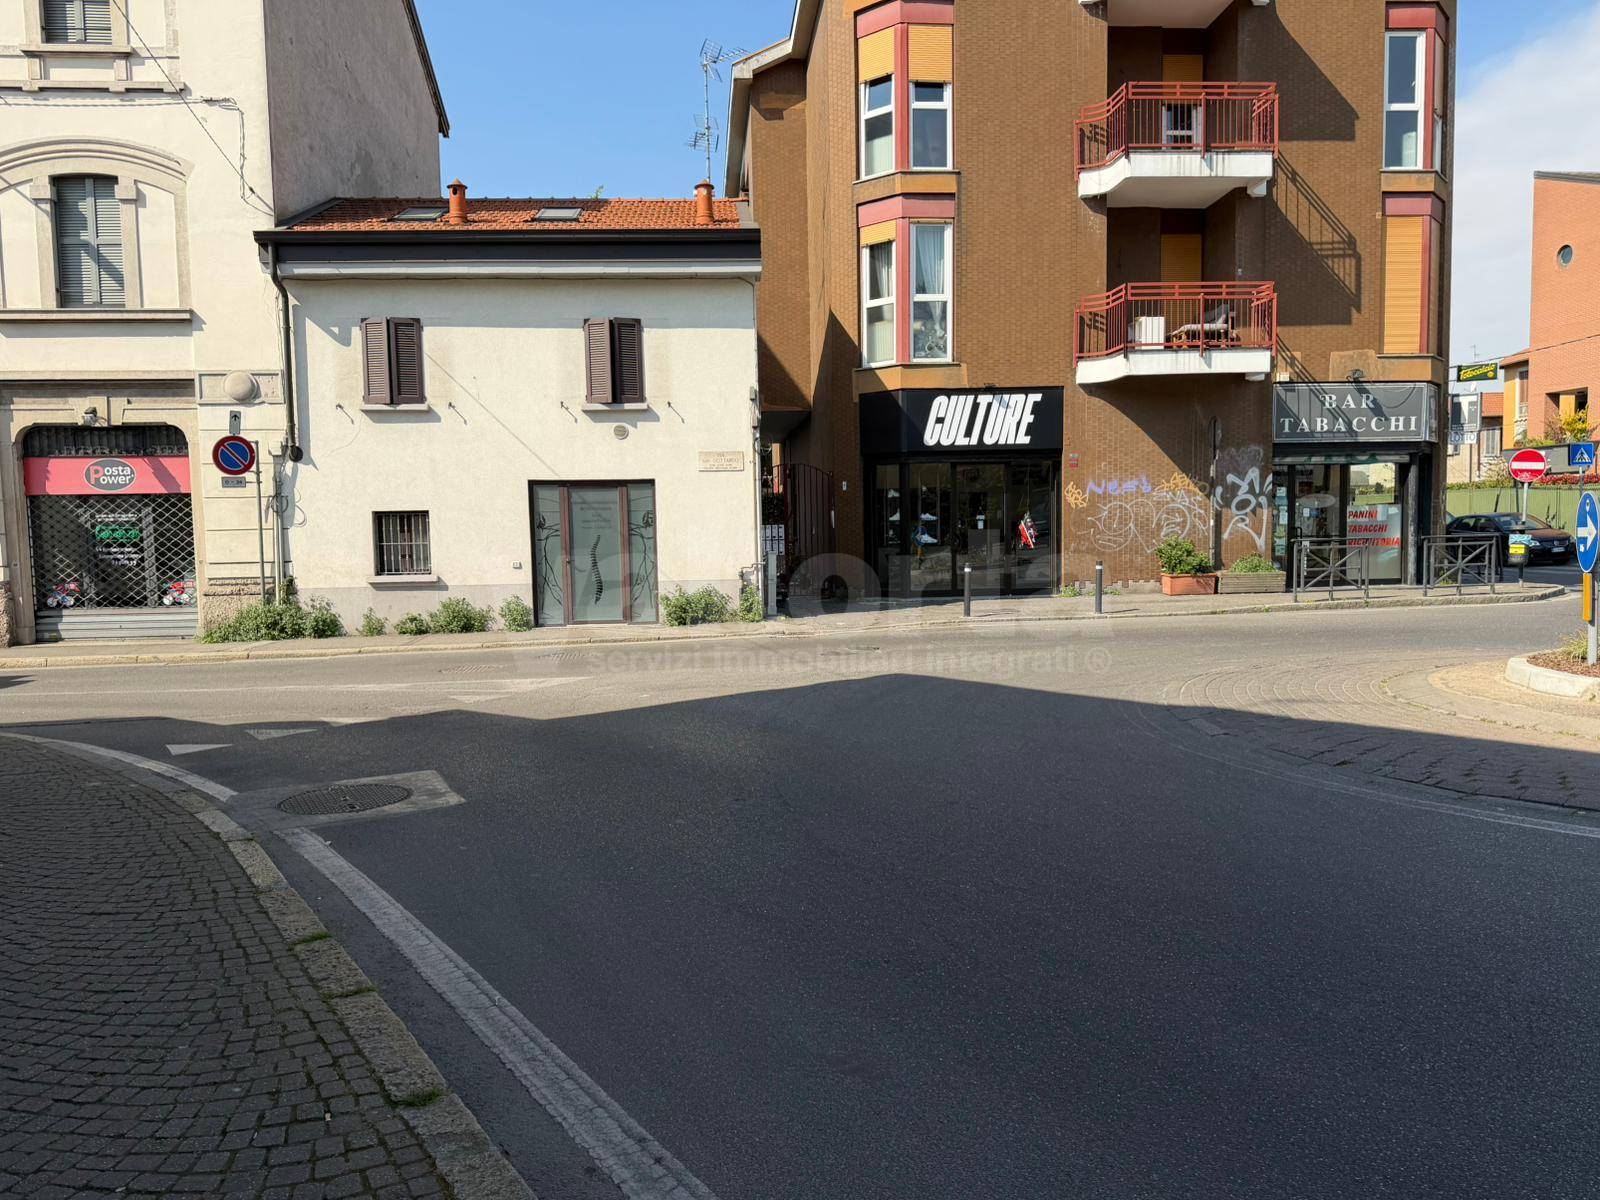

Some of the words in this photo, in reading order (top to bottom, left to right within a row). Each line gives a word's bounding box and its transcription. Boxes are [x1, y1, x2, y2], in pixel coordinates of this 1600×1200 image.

[1320, 393, 1376, 410] BAR
[923, 393, 1042, 446] CULTURE
[1280, 416, 1418, 434] TABACCHI
[1348, 509, 1378, 519] PANINI
[1347, 524, 1388, 533] TABACCHI
